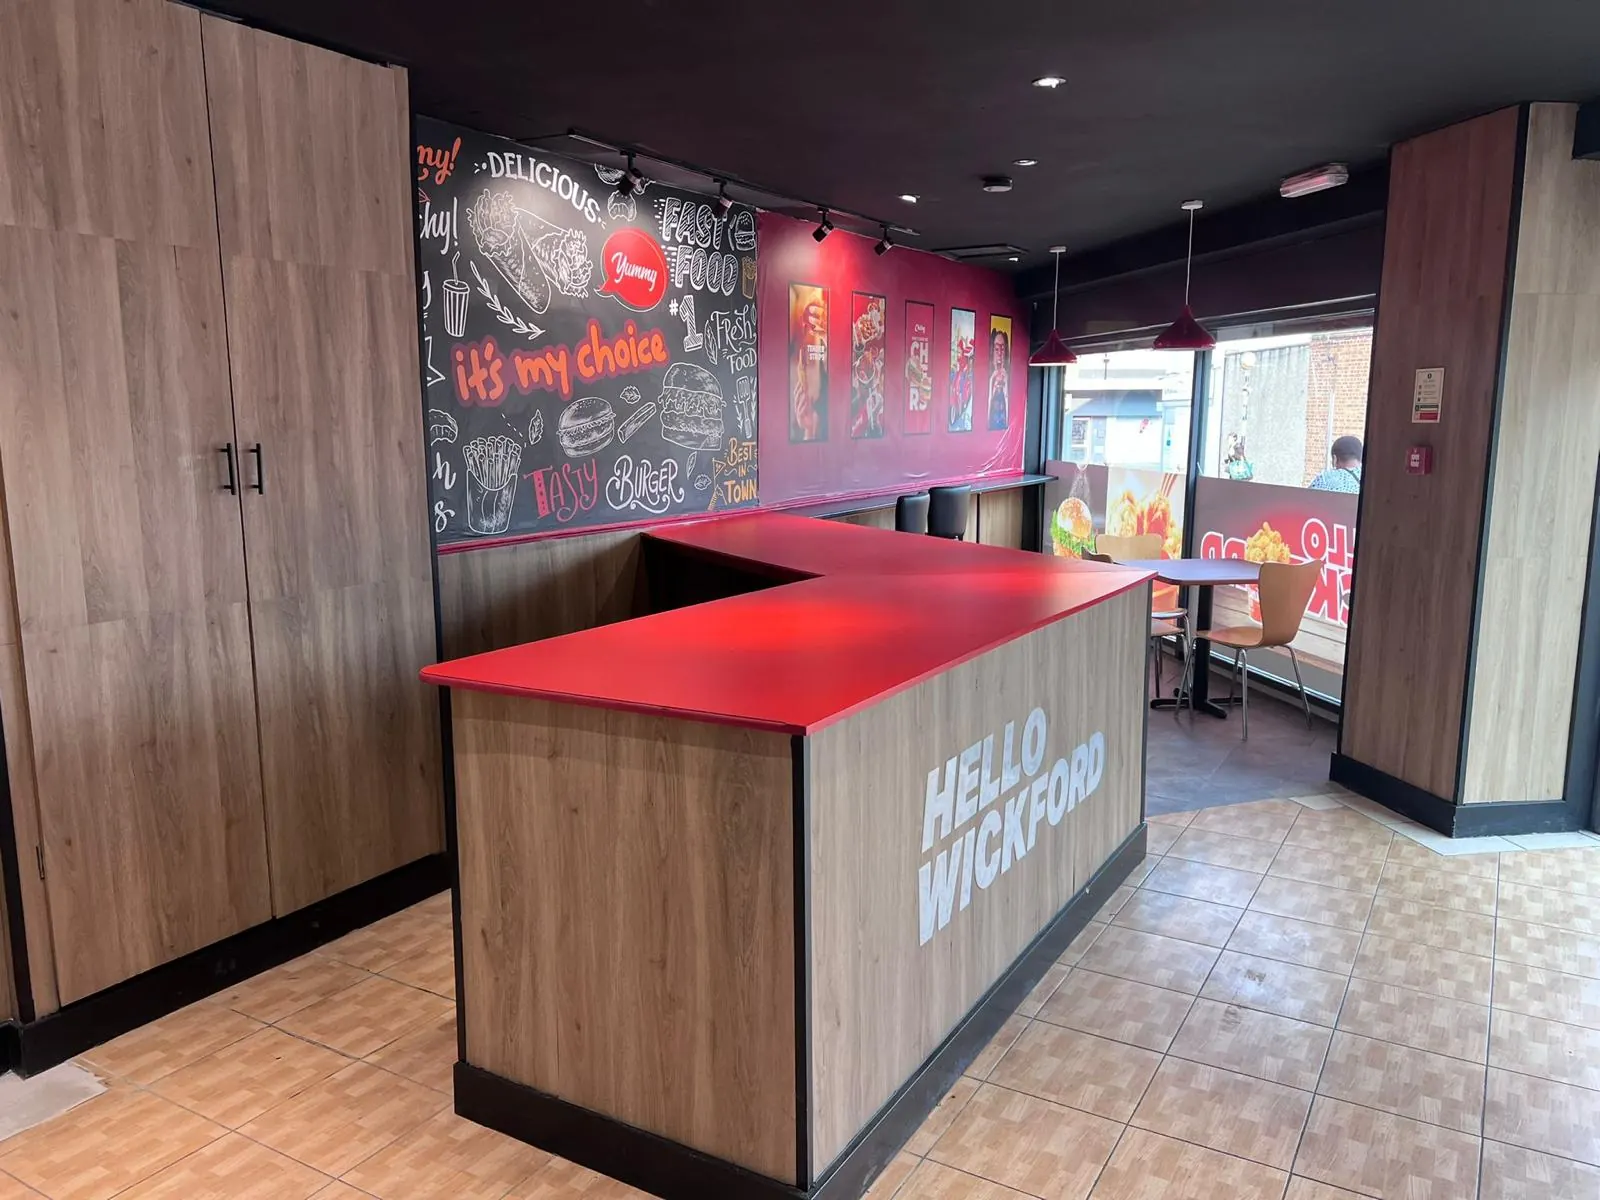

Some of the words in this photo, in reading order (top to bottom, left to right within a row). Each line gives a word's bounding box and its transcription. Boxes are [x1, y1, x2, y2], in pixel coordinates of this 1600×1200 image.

[487, 151, 602, 224] DELICIOUS
[662, 197, 729, 251] FAST
[611, 251, 658, 293] Yummy
[674, 244, 740, 297] FOOD
[456, 341, 503, 401] it's
[514, 349, 570, 395] my
[576, 324, 668, 378] choice
[726, 347, 758, 375] FOOD
[727, 437, 757, 467] BEST
[522, 457, 599, 523] TASTY
[605, 454, 685, 515] BURGER
[723, 478, 758, 504] TOWN
[921, 706, 1047, 854] HELLO
[918, 730, 1106, 947] WICKFORD
